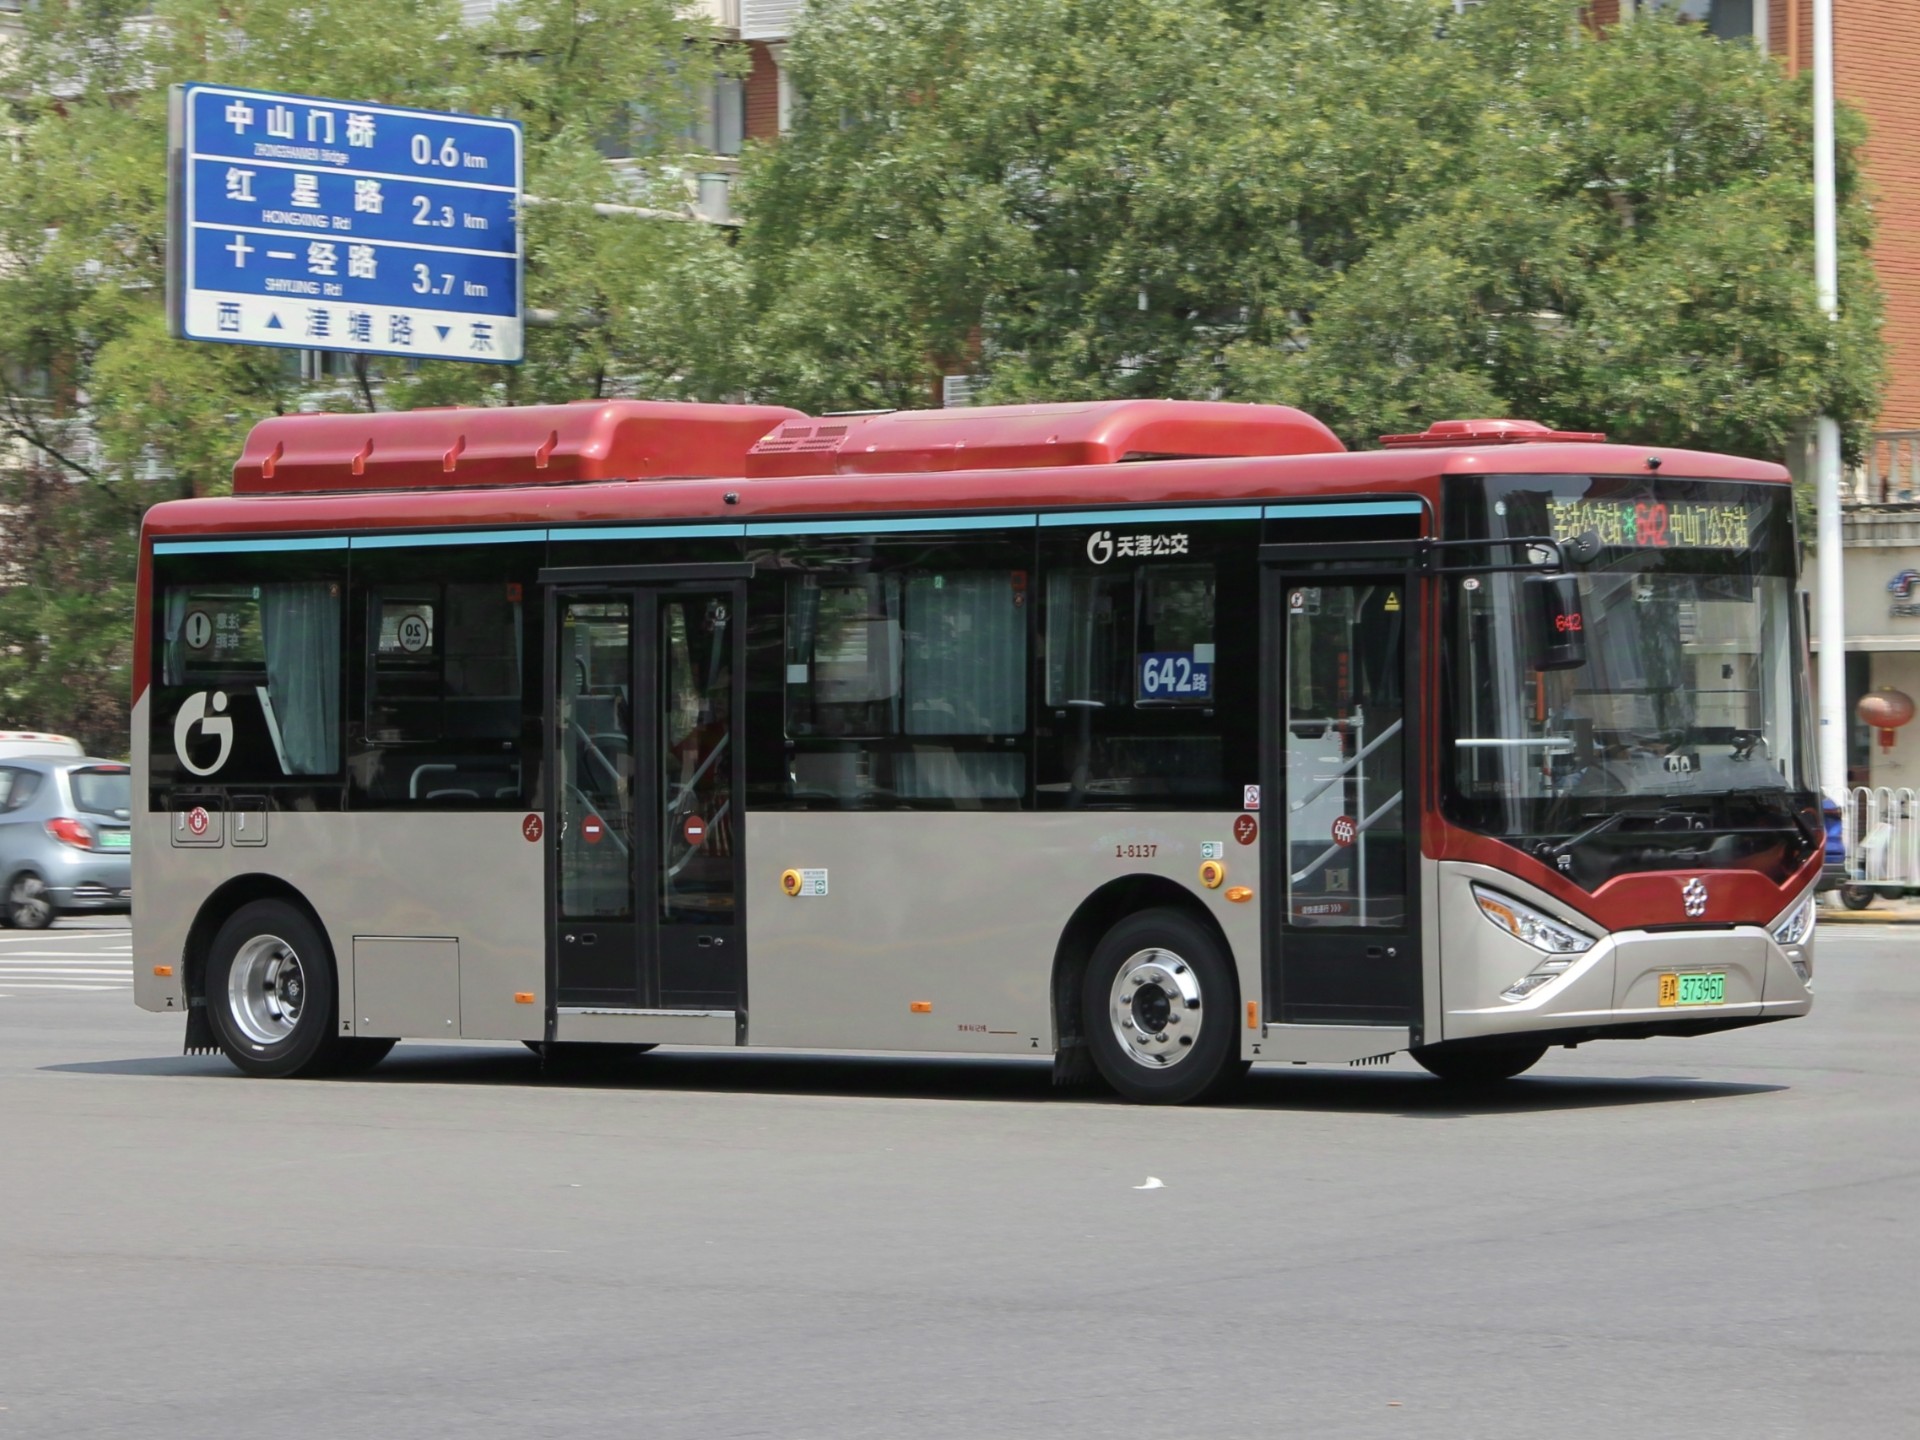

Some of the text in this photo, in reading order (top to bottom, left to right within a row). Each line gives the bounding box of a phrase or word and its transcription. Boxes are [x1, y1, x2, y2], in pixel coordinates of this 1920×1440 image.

[225, 100, 488, 169] 中山门桥 0.6 km
[225, 166, 489, 230] 红星路 2.3 km
[262, 210, 351, 231] HONGXING Rd
[225, 234, 489, 298] 十一经路 3.7 km
[323, 281, 343, 297] Rd
[217, 302, 494, 352] 西 津塘路 东
[1669, 504, 1749, 547] 中山门公交站
[1117, 532, 1189, 558] 天津公交
[1555, 612, 1582, 632] 642
[1143, 657, 1207, 693] 642路
[1115, 844, 1158, 858] 1-8137
